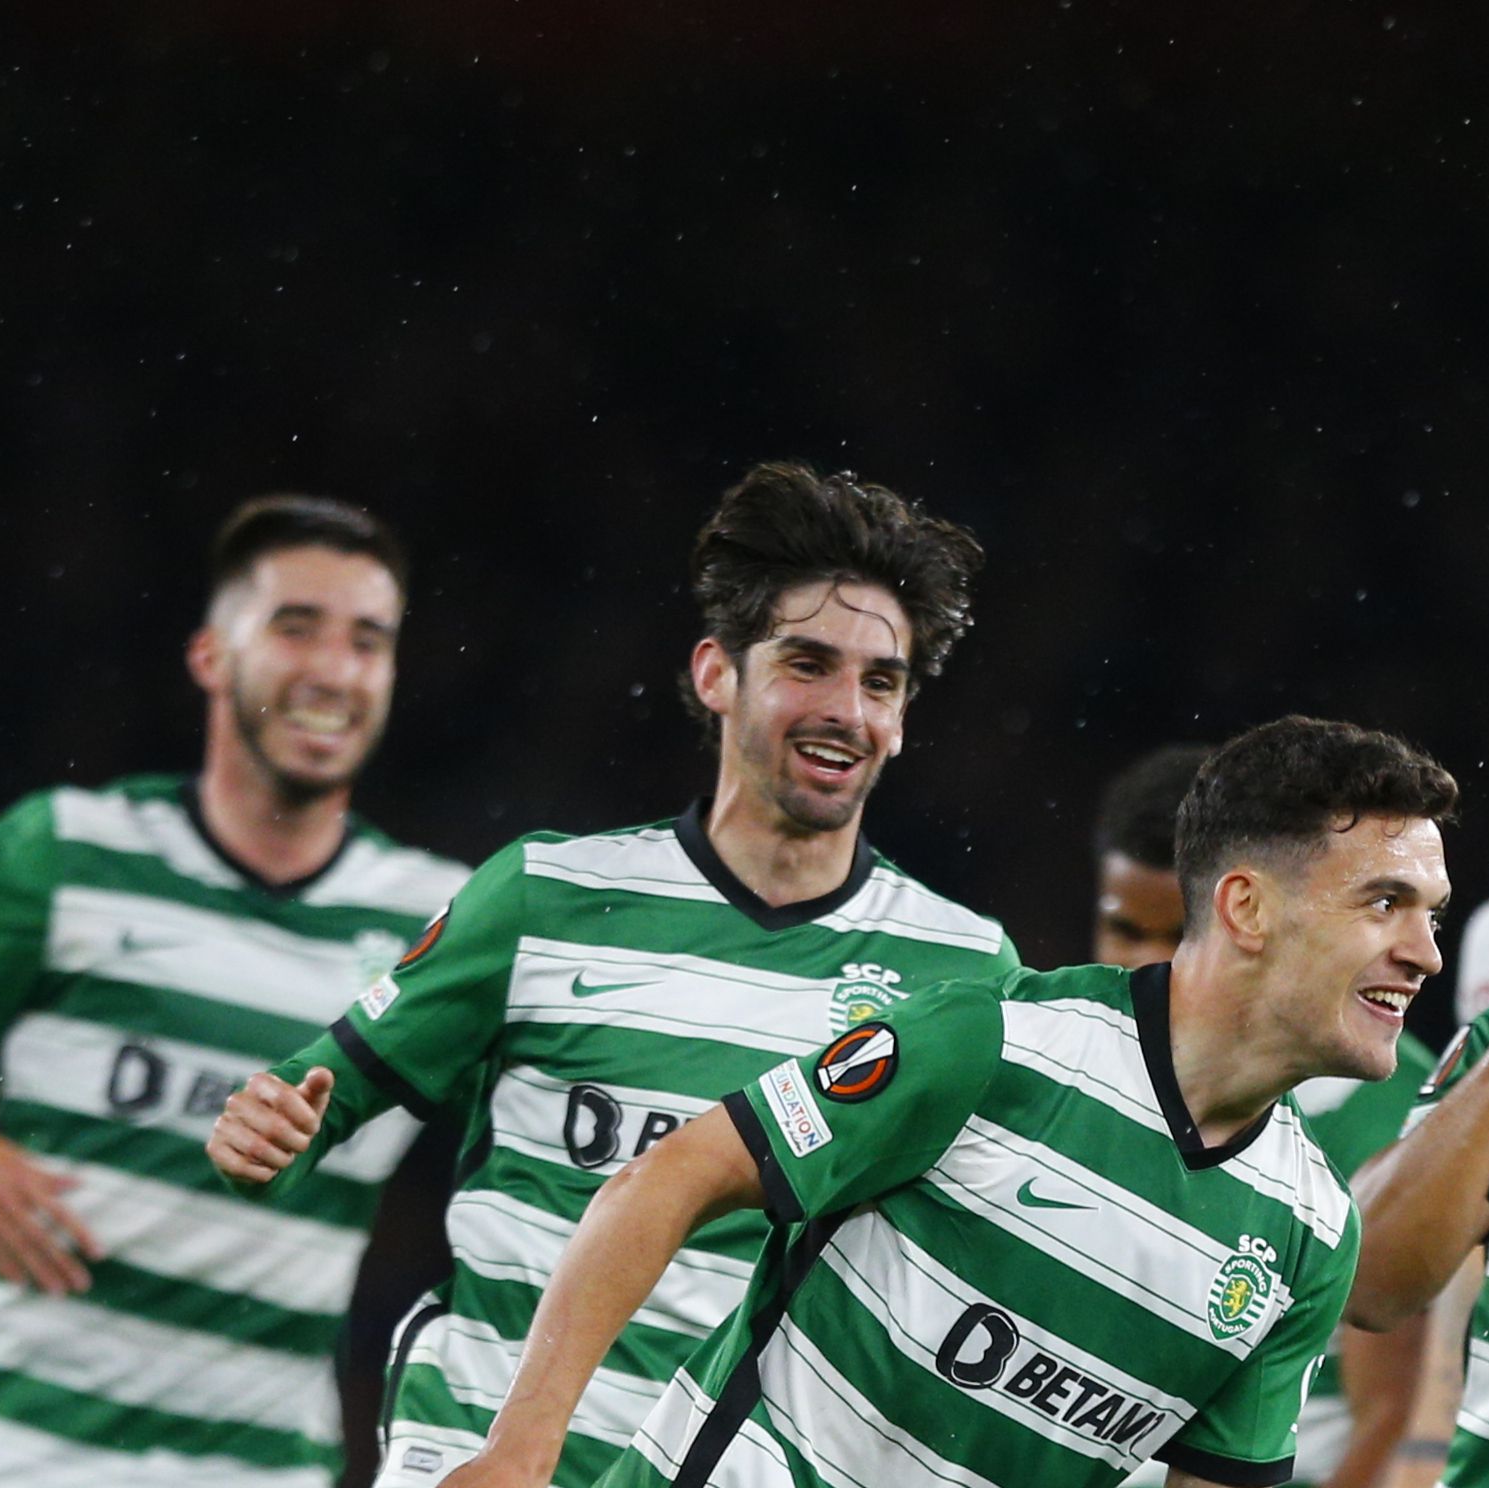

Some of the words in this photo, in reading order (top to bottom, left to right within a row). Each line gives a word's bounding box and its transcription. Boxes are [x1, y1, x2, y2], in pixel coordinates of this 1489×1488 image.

[841, 963, 902, 985] SCP
[836, 985, 894, 1005] SPORTIN
[1239, 1234, 1278, 1262] SCP
[1225, 1259, 1267, 1293] SPORTING
[1003, 1352, 1166, 1448] BETAN
